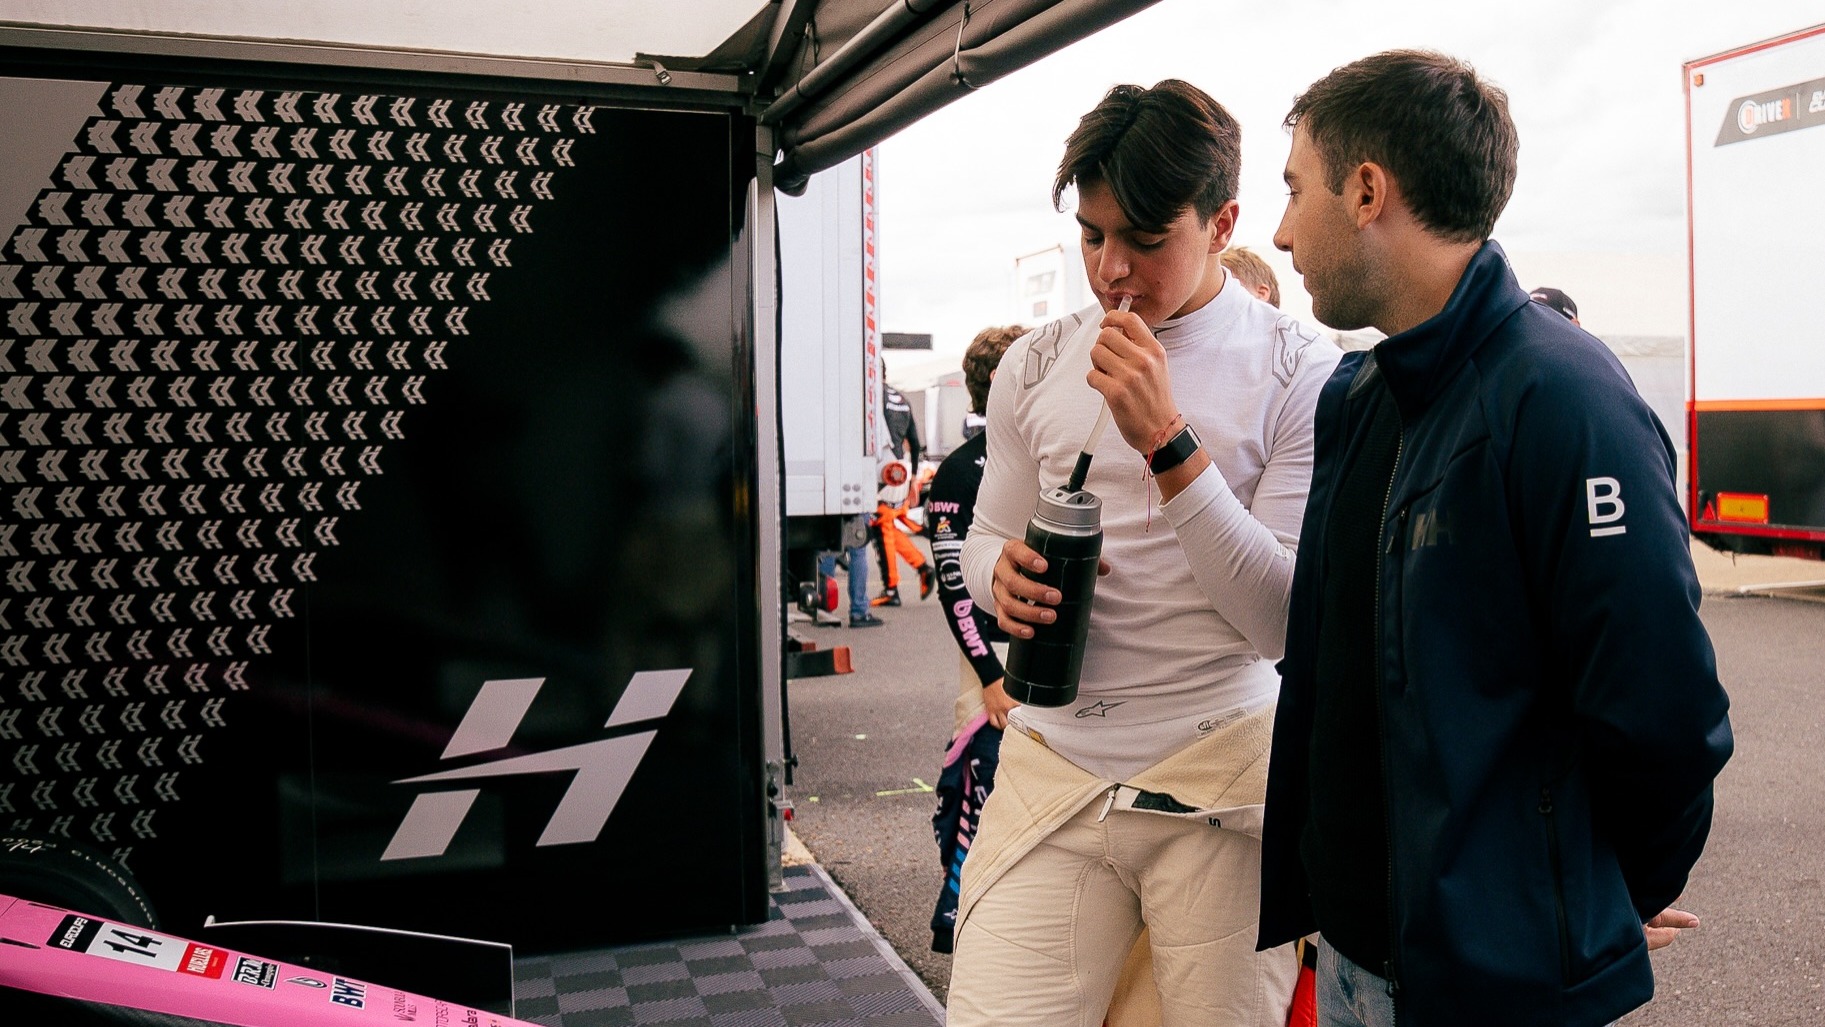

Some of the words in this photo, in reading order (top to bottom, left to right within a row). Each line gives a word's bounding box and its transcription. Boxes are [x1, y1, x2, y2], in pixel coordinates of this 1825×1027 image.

[934, 502, 960, 514] BWT
[1586, 476, 1626, 526] B
[957, 615, 989, 658] BWT
[102, 928, 163, 959] 14
[331, 977, 366, 1010] BWT
